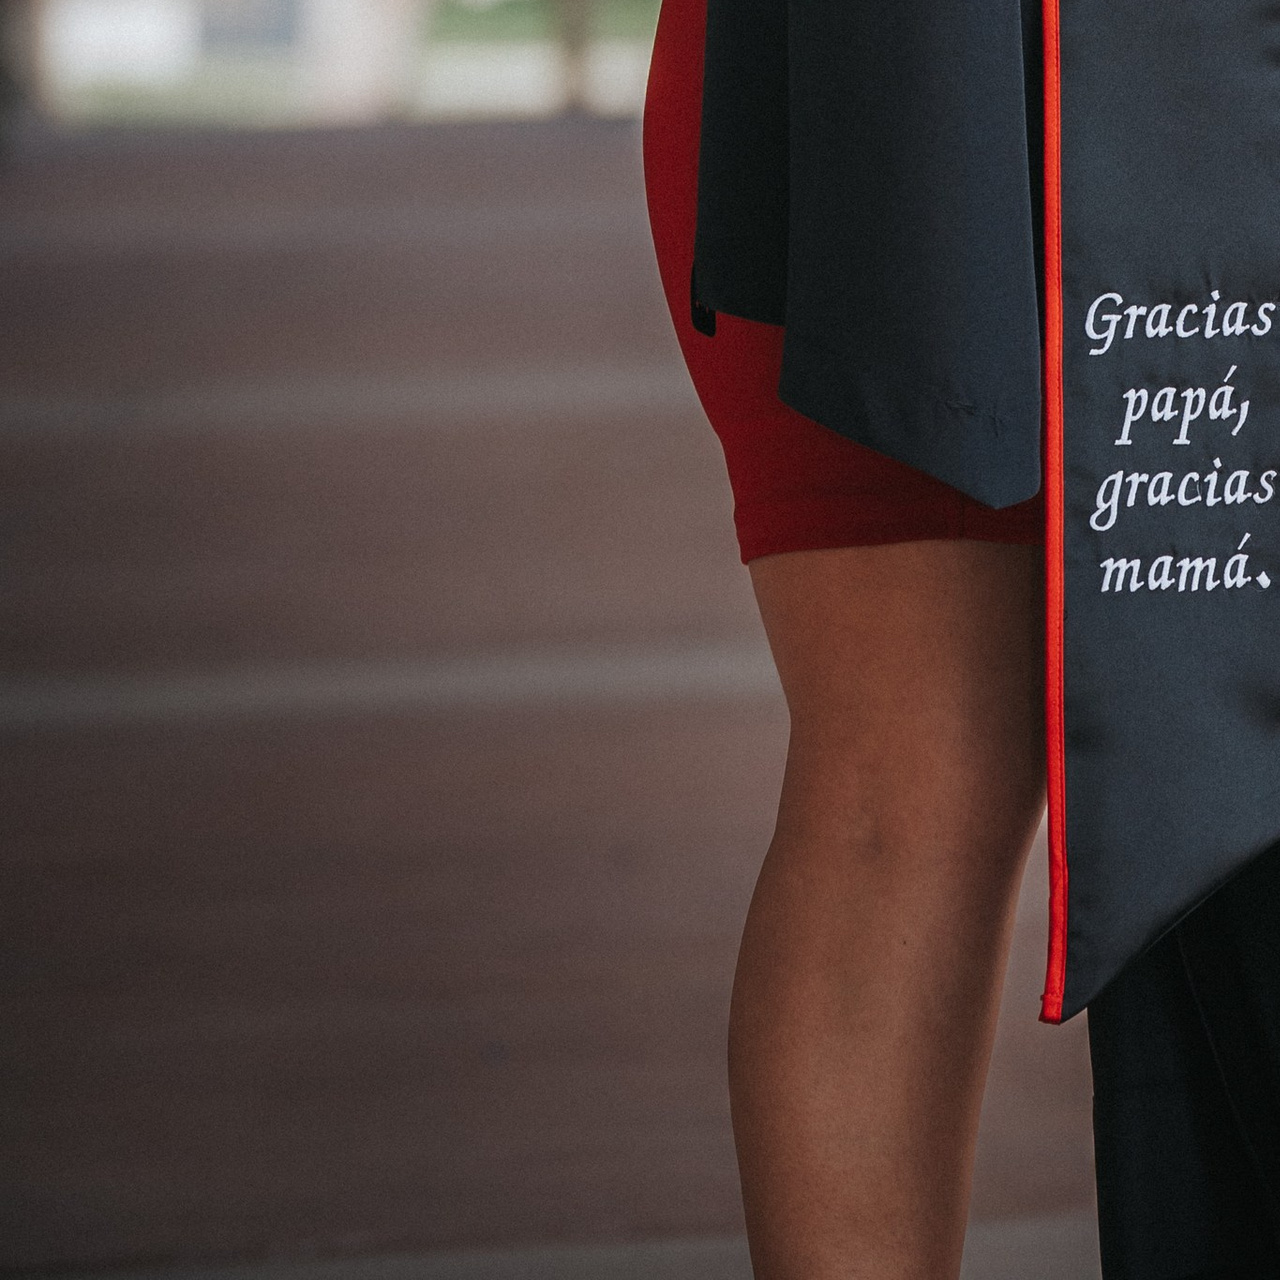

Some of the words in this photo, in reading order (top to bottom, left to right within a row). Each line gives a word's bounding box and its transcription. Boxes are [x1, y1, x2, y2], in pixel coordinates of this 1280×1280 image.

[1085, 289, 1277, 356] Gracias
[1114, 364, 1250, 446] papá,
[1089, 457, 1278, 532] gracias
[1100, 532, 1272, 593] mamá.
